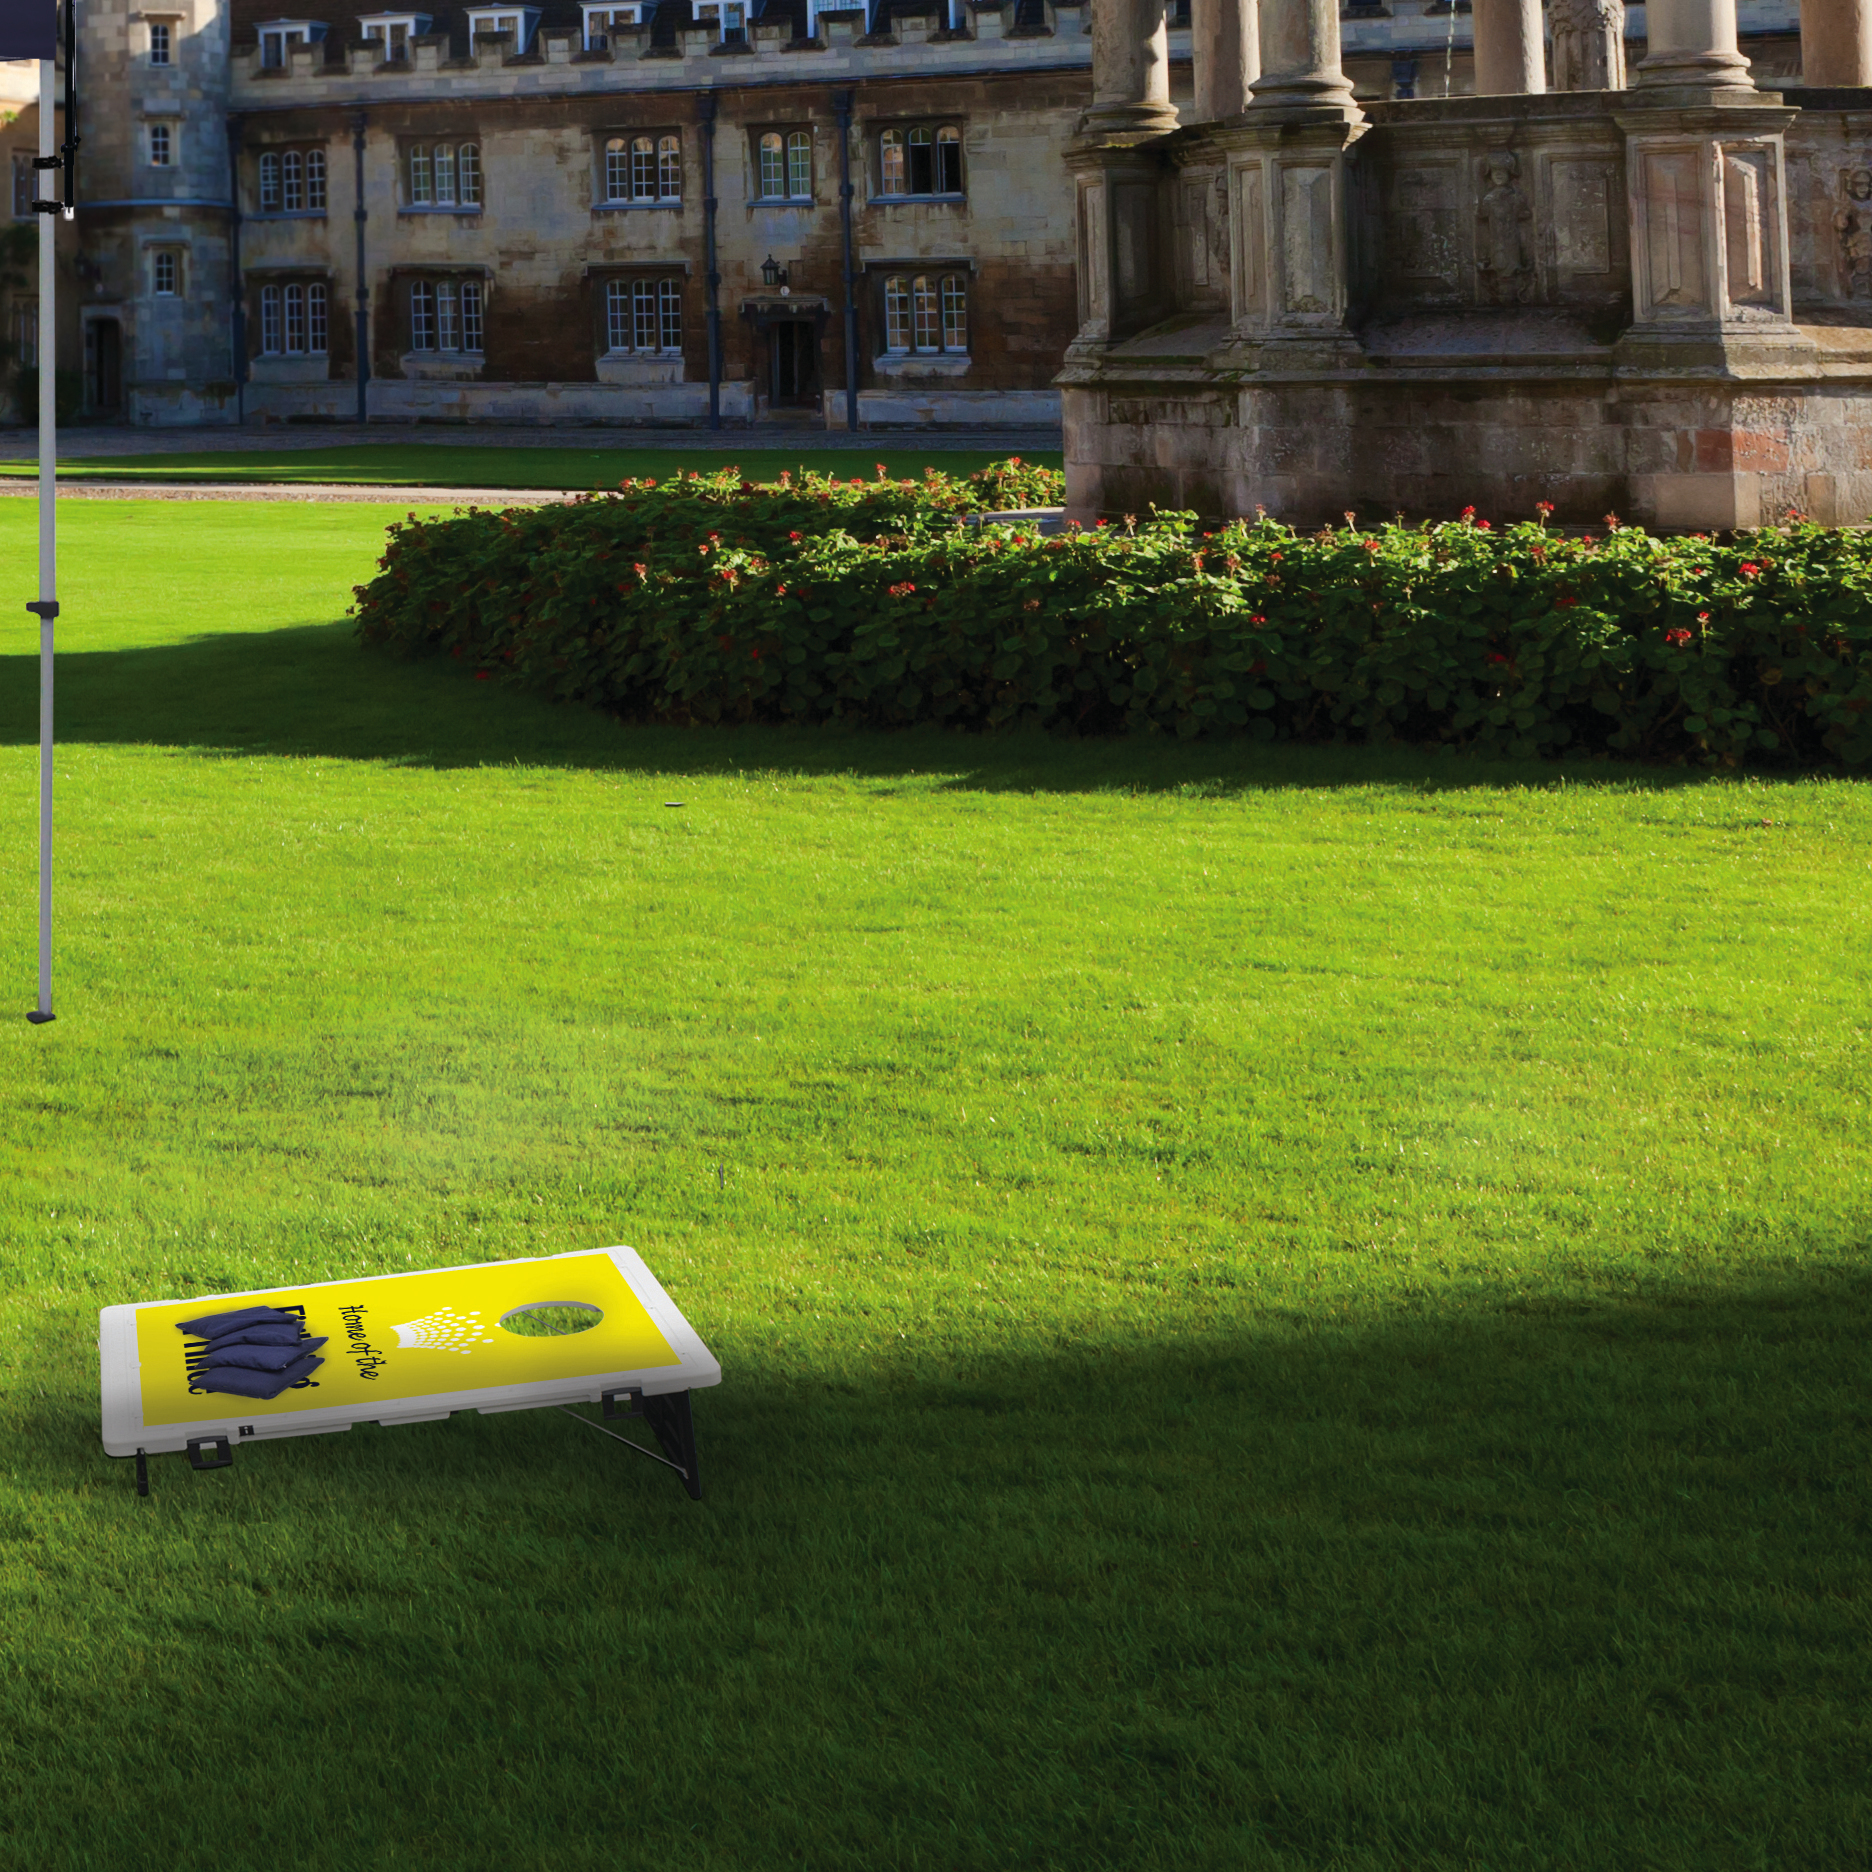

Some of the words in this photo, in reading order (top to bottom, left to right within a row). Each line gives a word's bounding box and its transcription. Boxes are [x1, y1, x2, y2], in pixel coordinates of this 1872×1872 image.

[337, 1304, 369, 1342] Home
[345, 1342, 383, 1357] of
[355, 1356, 388, 1381] the
